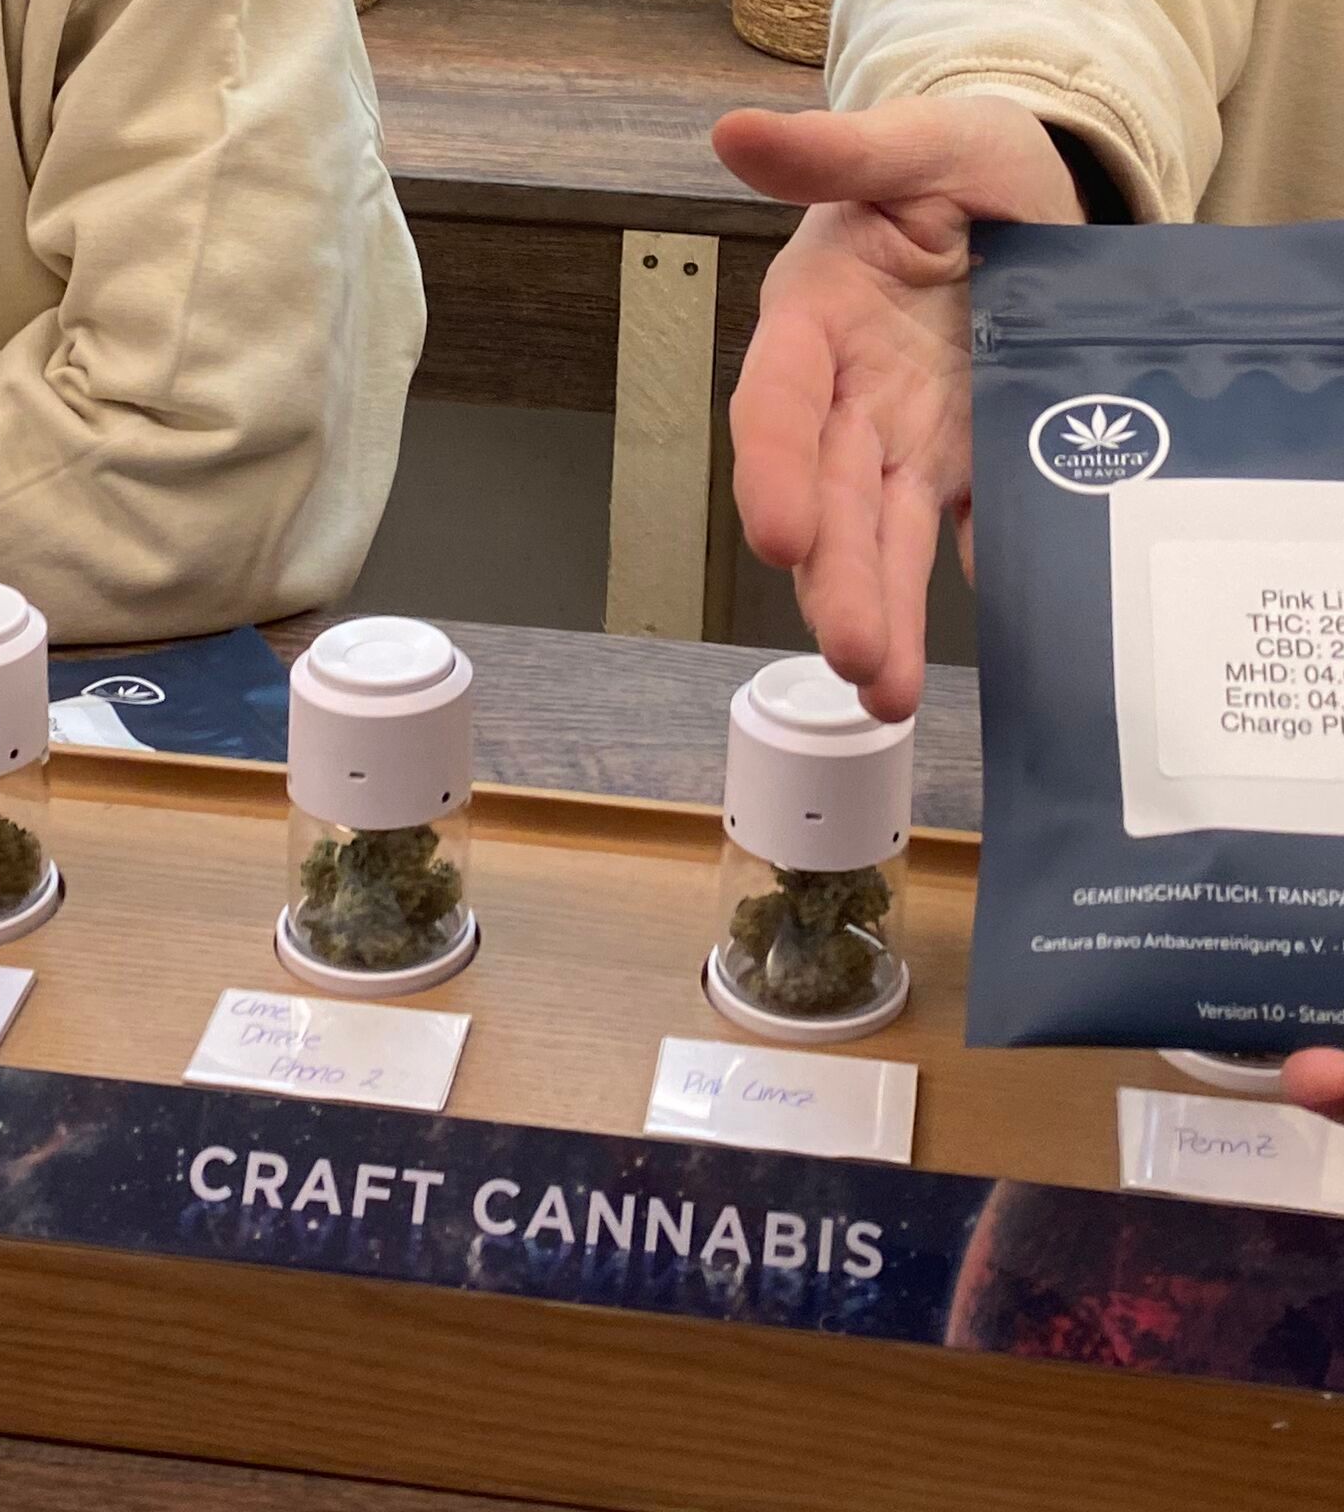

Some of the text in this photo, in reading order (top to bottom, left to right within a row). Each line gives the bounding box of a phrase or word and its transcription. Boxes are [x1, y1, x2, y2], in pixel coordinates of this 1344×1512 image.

[1054, 451, 1144, 468] cantura
[1074, 468, 1126, 479] BRAVO
[1261, 589, 1314, 610] Pink
[1246, 613, 1312, 635] THC:
[1256, 637, 1322, 660] CBD:
[1225, 663, 1296, 684] MHD:
[1225, 688, 1300, 710] Ernte:
[1220, 711, 1312, 739] Charge
[1031, 936, 1093, 952] Cantura
[1096, 933, 1140, 950] Bravo
[1143, 933, 1291, 956] Anbauvereinigung
[1197, 1002, 1257, 1020] Version
[359, 1068, 384, 1088] 2
[189, 1146, 884, 1280] CRAFT CANNABIS
